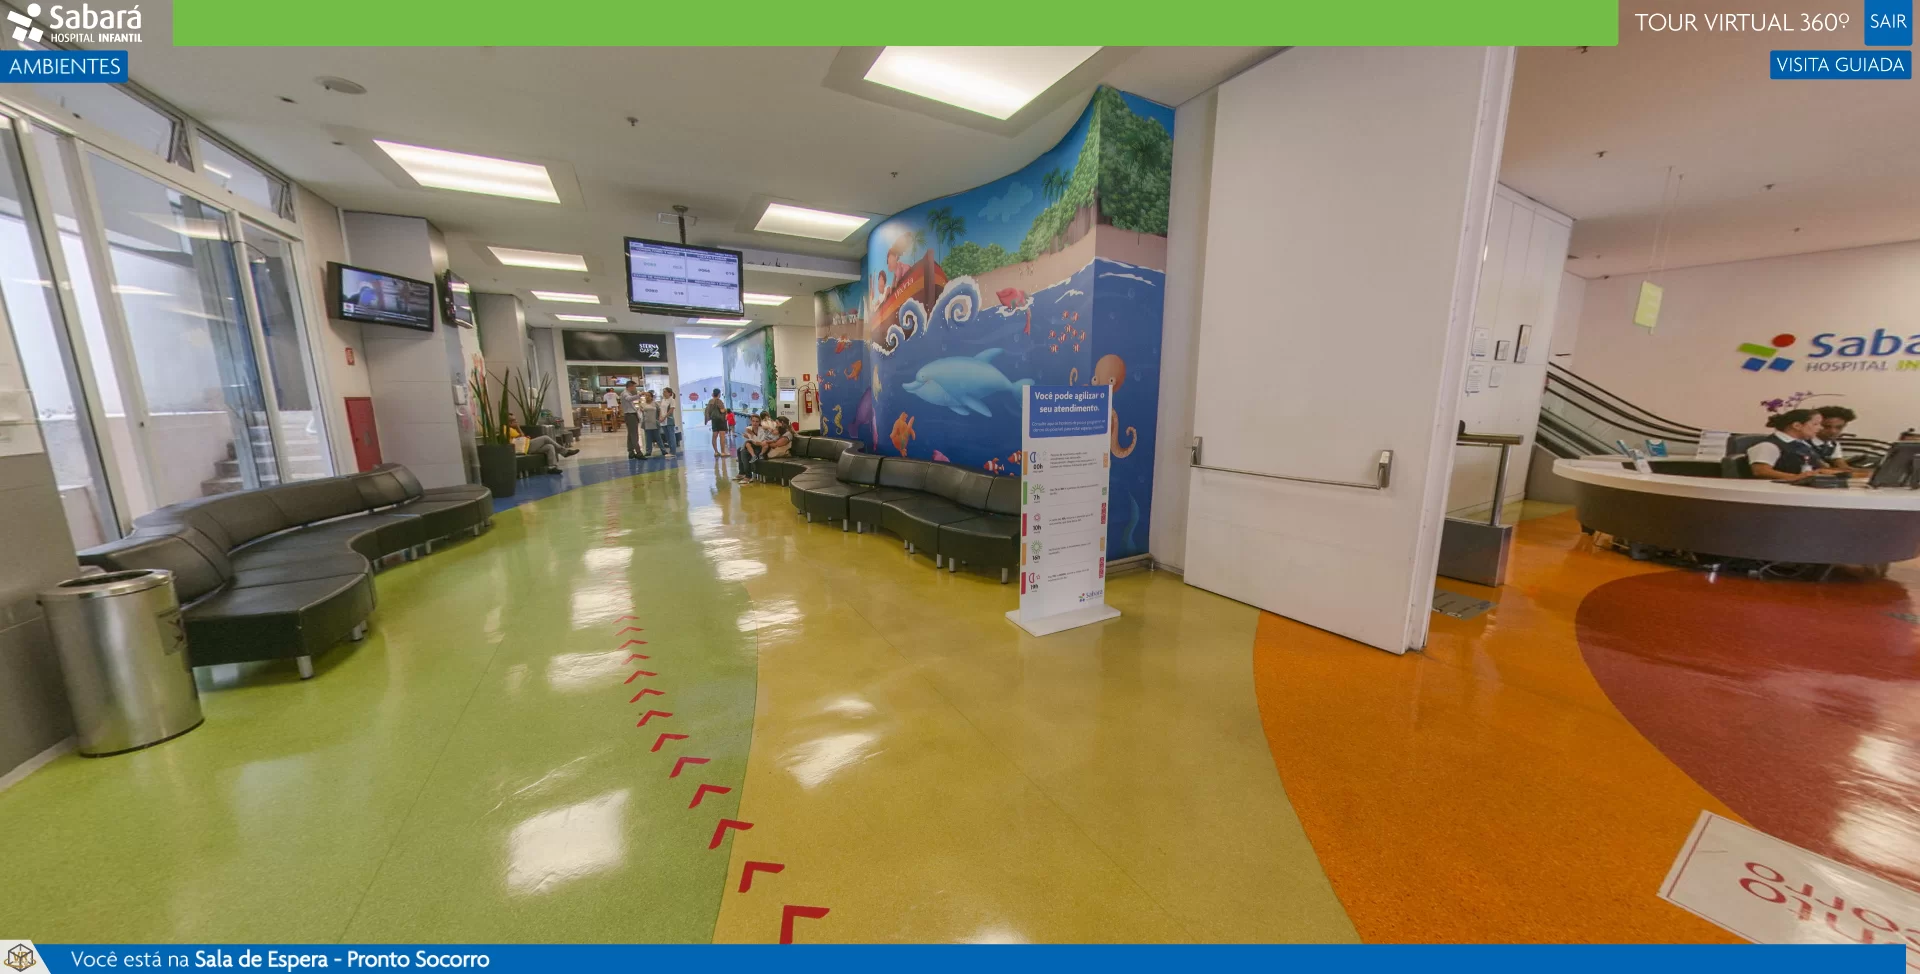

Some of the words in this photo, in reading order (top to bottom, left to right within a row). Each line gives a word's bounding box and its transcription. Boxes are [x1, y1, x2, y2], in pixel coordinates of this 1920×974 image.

[1806, 359, 1888, 372] HOSPITAL
[1034, 391, 1053, 400] Você
[1054, 391, 1073, 402] pode
[1074, 391, 1098, 402] agilizar
